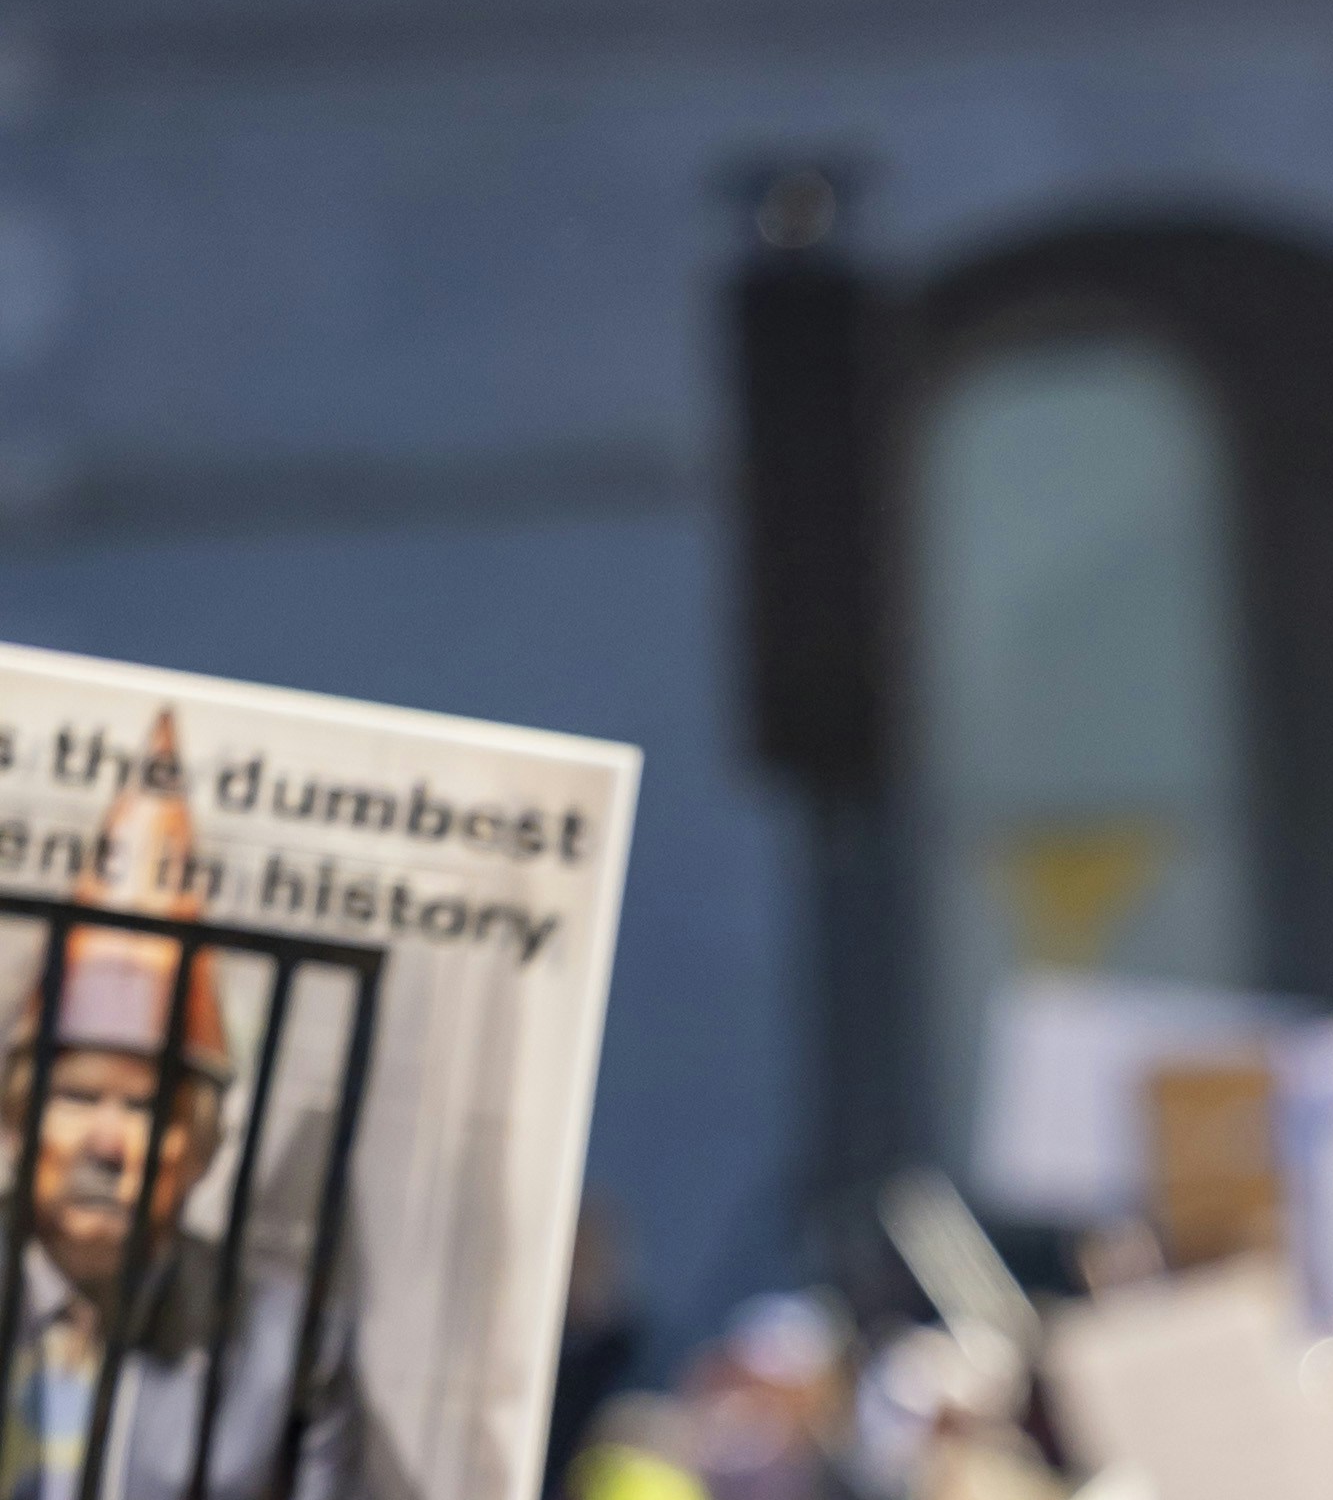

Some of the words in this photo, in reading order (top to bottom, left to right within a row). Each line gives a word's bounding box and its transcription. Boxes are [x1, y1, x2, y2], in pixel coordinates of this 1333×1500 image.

[53, 722, 184, 791] the
[215, 752, 584, 867] dumbest
[155, 852, 226, 894] in
[259, 850, 562, 968] history
